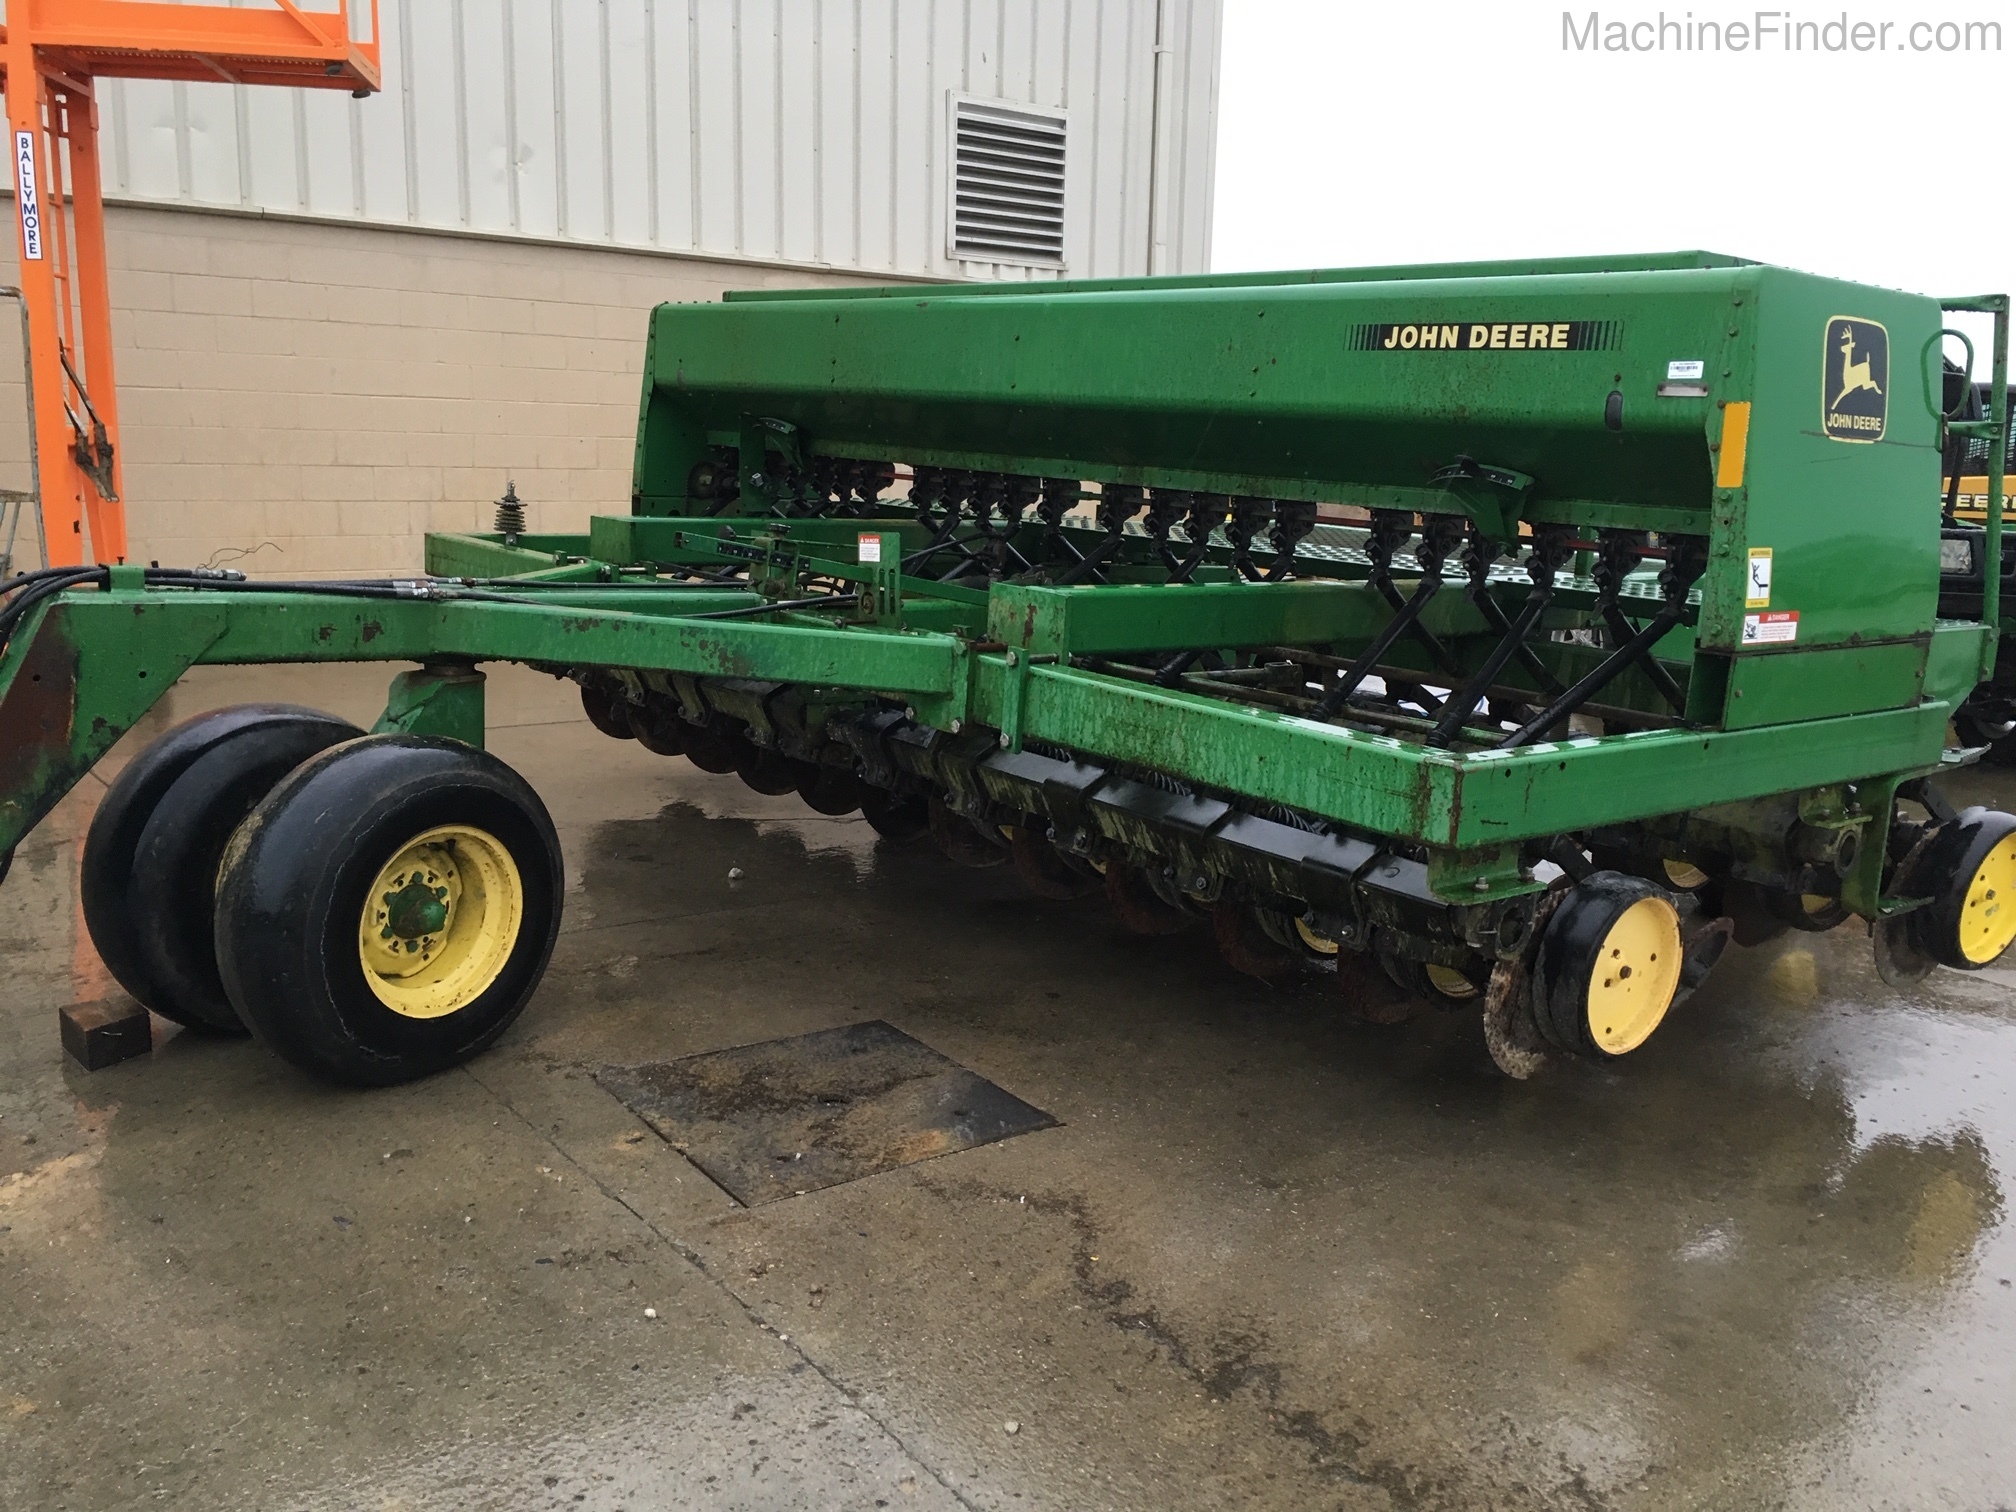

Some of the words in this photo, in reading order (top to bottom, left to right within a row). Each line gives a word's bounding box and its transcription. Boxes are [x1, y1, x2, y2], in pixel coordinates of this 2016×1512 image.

[20, 137, 38, 254] BALLYMORE
[1384, 325, 1460, 349] JOHN
[1469, 324, 1570, 348] DEERE
[1827, 413, 1852, 428] JOHN
[1853, 415, 1882, 431] DEERE
